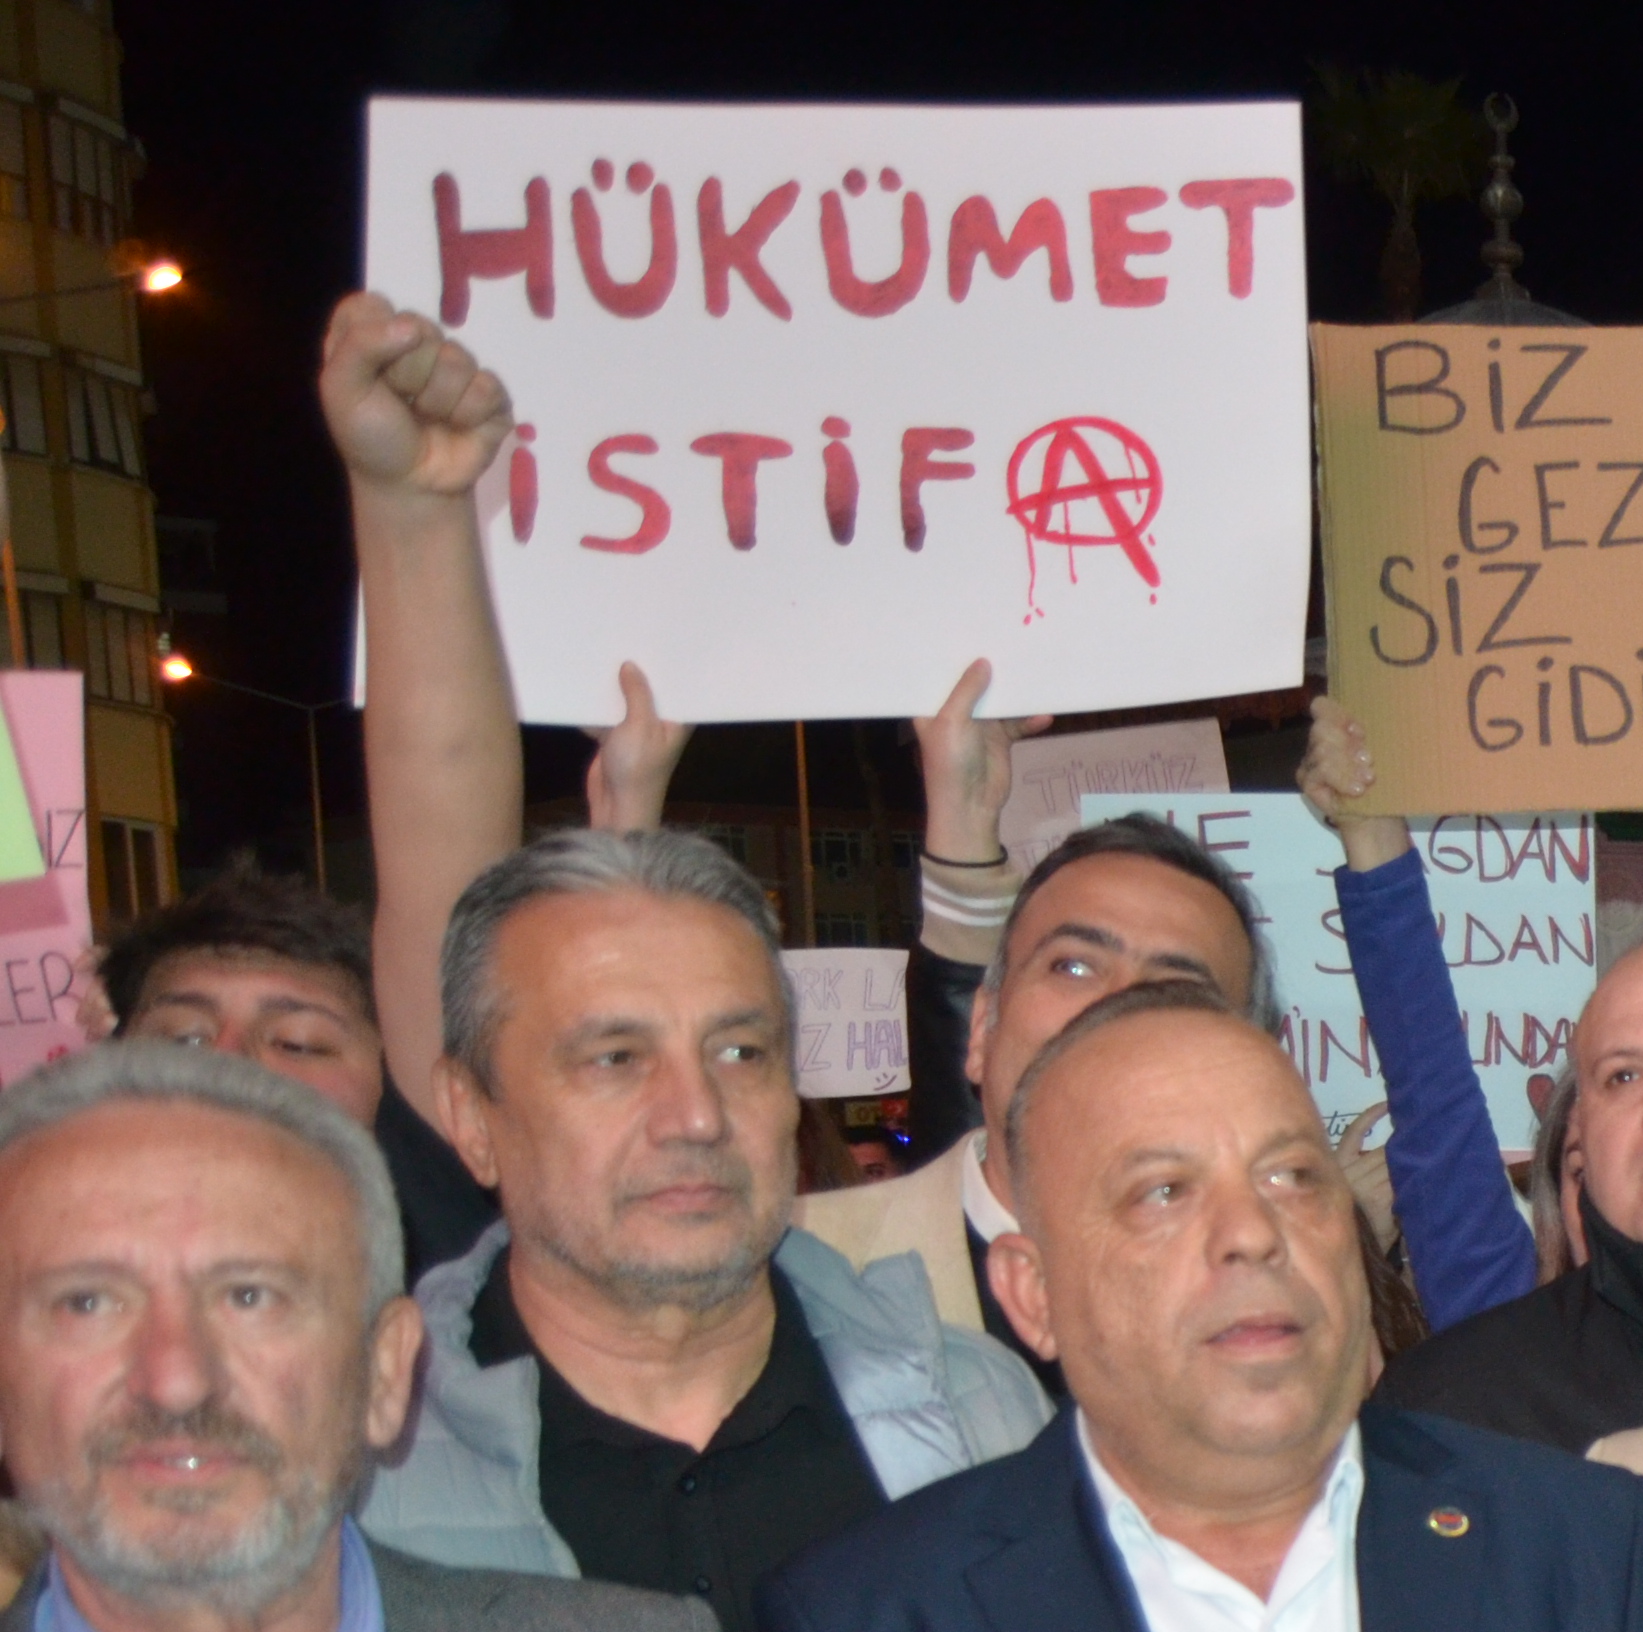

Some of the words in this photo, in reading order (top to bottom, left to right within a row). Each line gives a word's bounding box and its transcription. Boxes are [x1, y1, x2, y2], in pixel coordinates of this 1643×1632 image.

[433, 157, 1295, 327] HÜKÜMET
[1374, 338, 1613, 435] BİZ
[1370, 553, 1572, 668] SİZ
